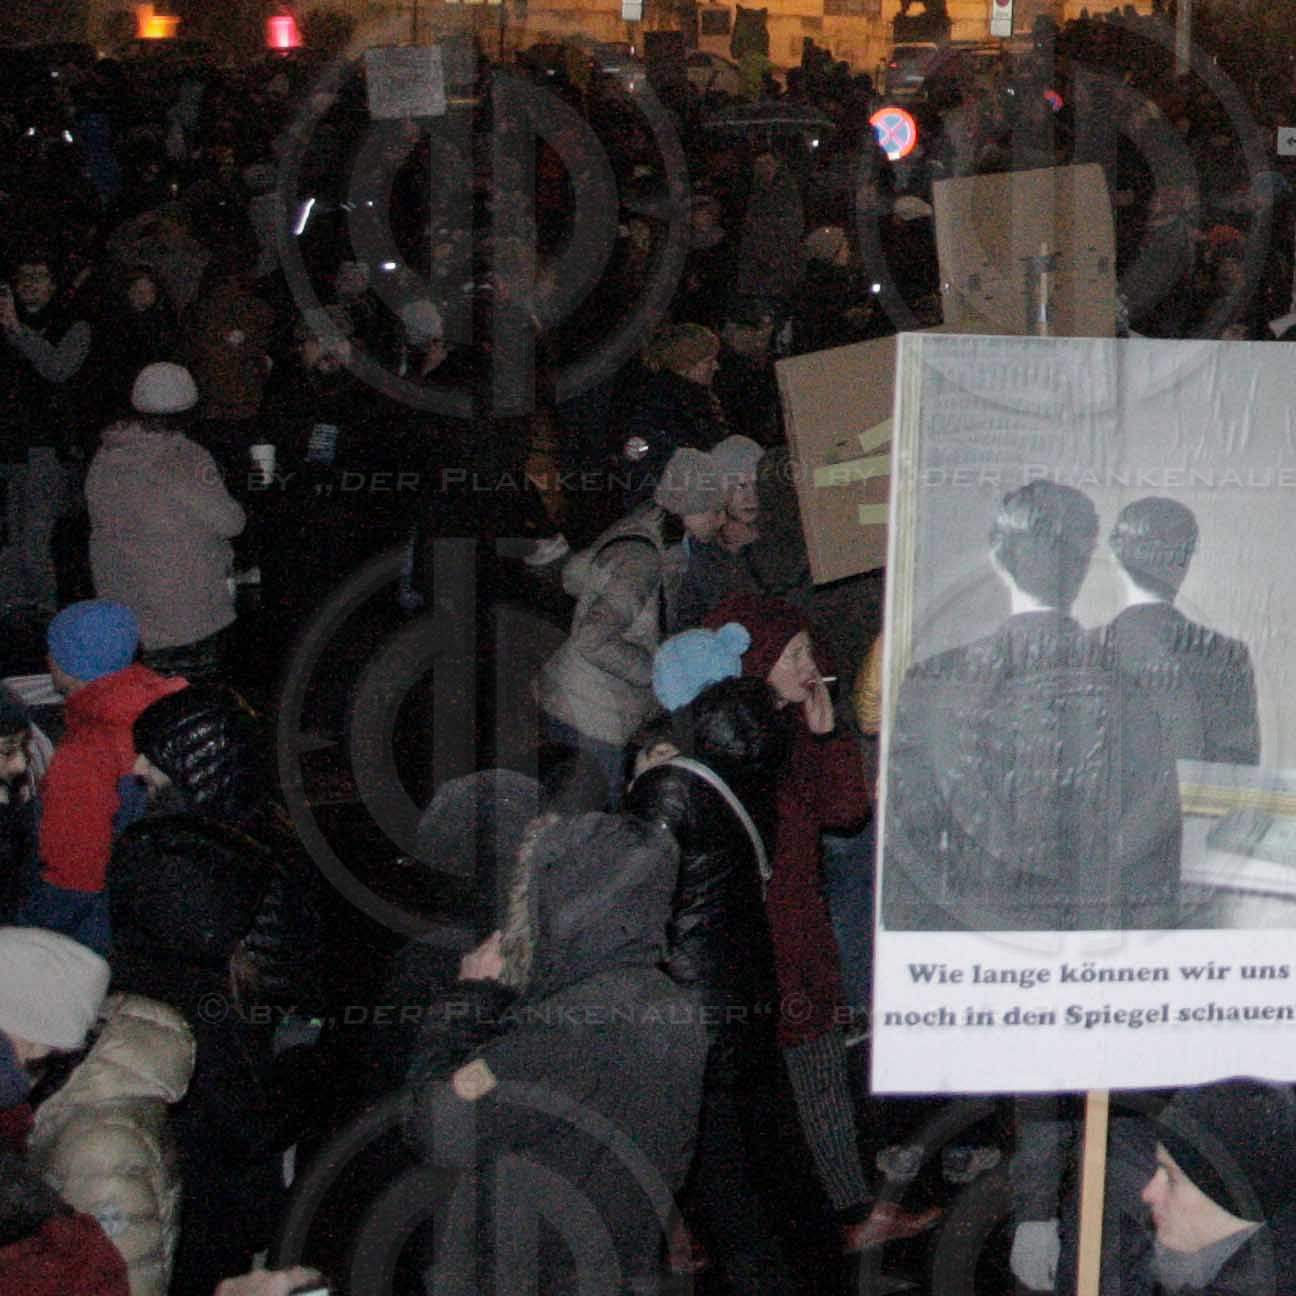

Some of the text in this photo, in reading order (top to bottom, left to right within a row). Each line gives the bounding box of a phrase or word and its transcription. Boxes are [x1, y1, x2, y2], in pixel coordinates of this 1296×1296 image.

[908, 961, 1290, 989] Wie lange können wir uns
[883, 1004, 956, 1026] noch
[964, 1005, 994, 1026] in
[1003, 1005, 1056, 1026] den
[1065, 1001, 1170, 1030] Spiegel
